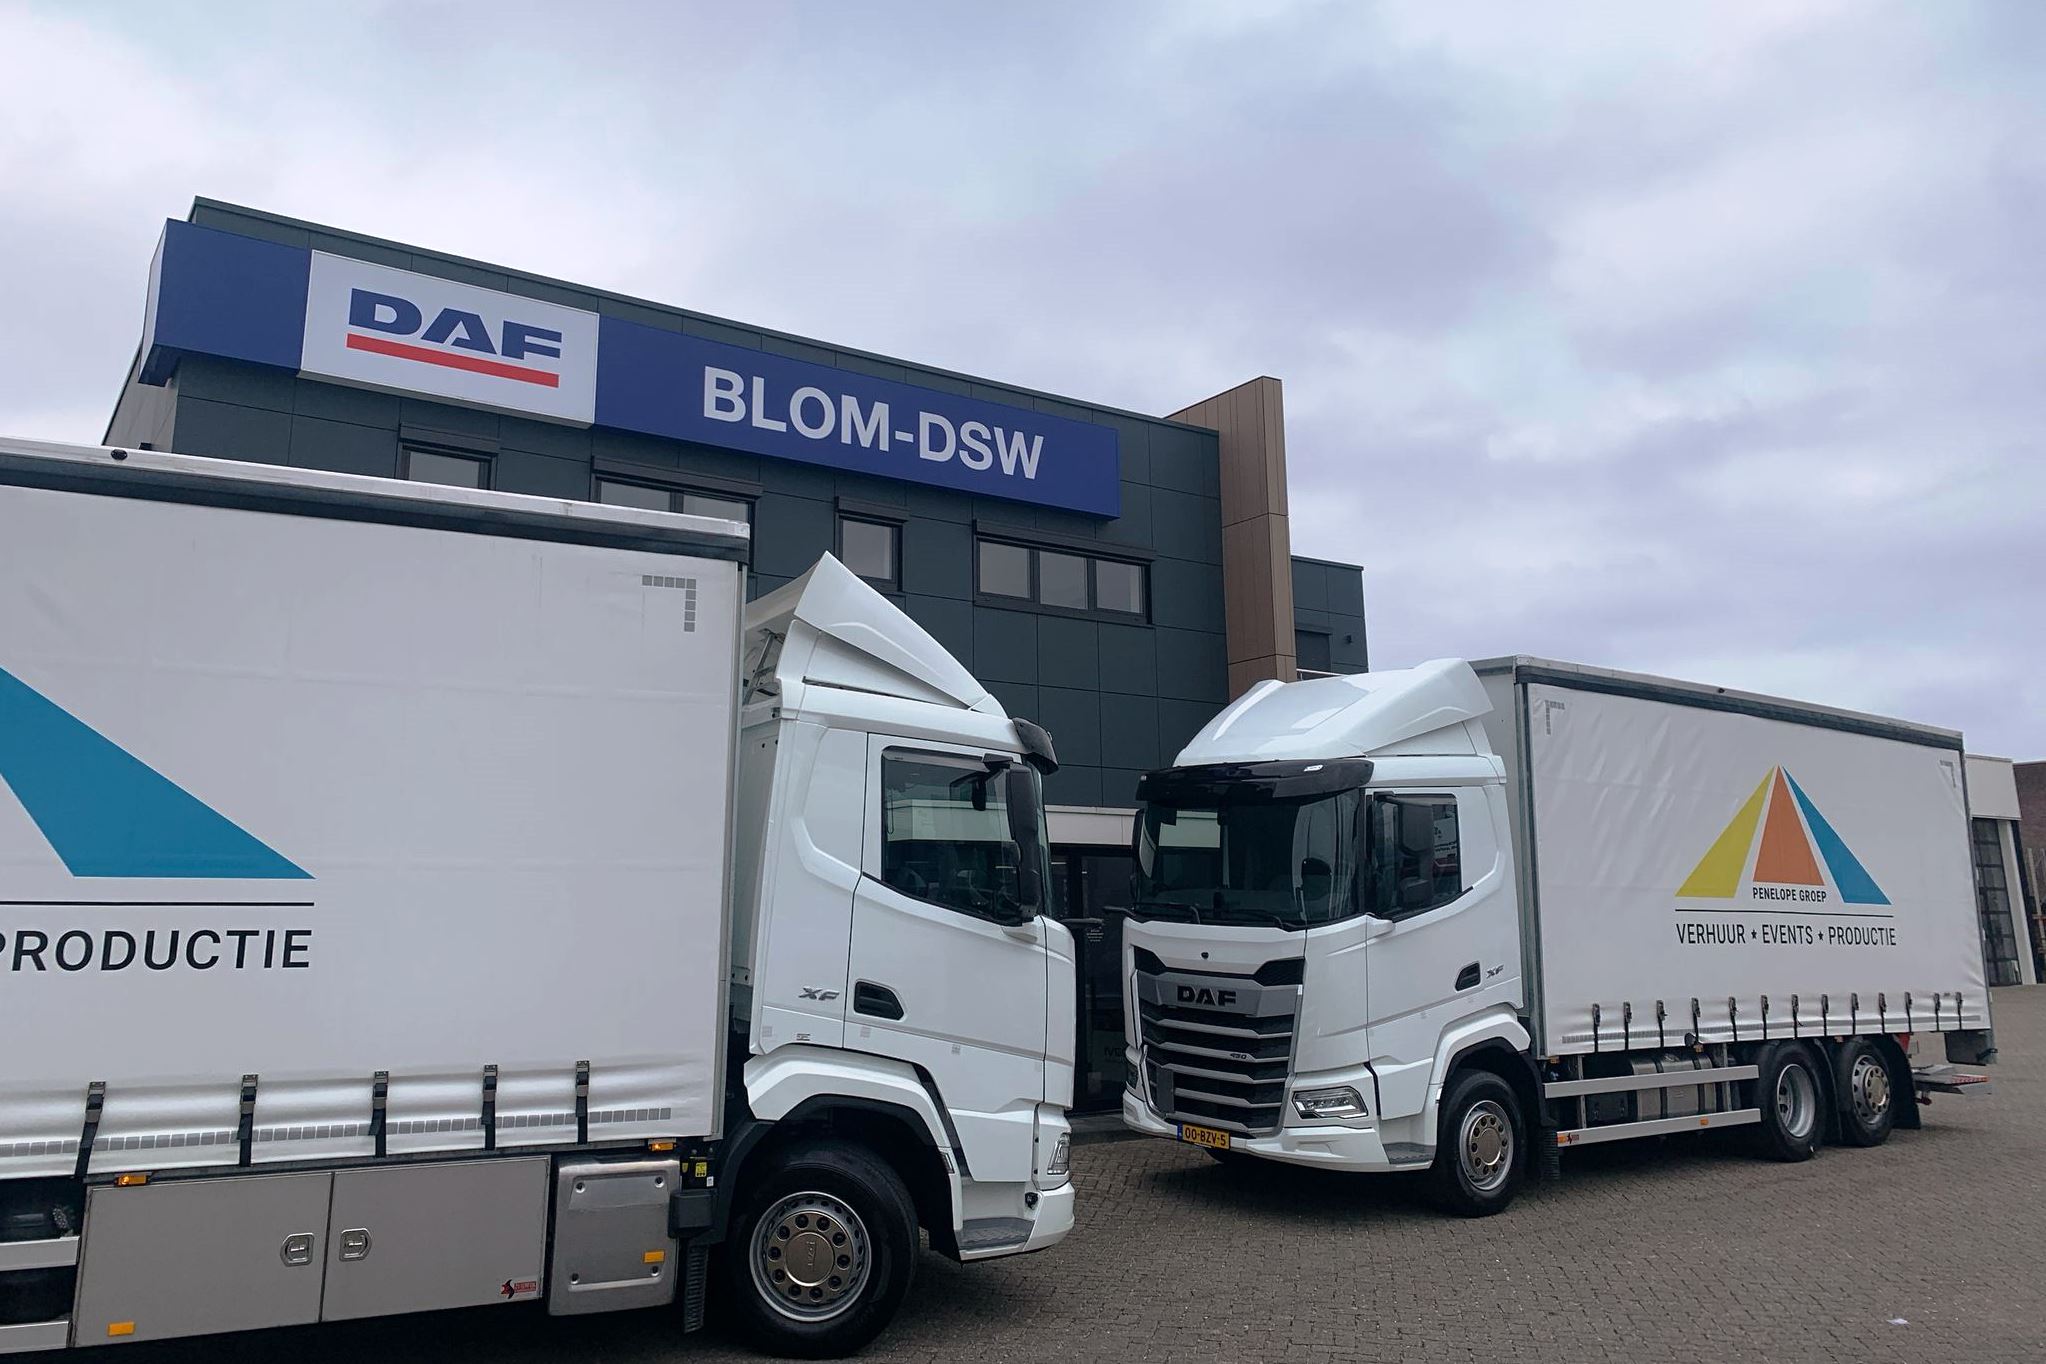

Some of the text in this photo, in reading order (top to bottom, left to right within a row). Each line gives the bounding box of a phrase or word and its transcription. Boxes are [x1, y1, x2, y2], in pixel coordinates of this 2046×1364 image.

[349, 288, 563, 360] DAF
[703, 366, 1044, 479] BLOM-DSW
[1752, 887, 1827, 903] PENELOPE GROEP
[1676, 923, 1897, 946] VERHUUR EVENTS PRODUCTIE
[0, 929, 313, 972] RODUCTIE
[798, 986, 840, 1001] XF
[1177, 985, 1237, 1007] DAF
[1184, 1127, 1226, 1147] 00-BZV-5
